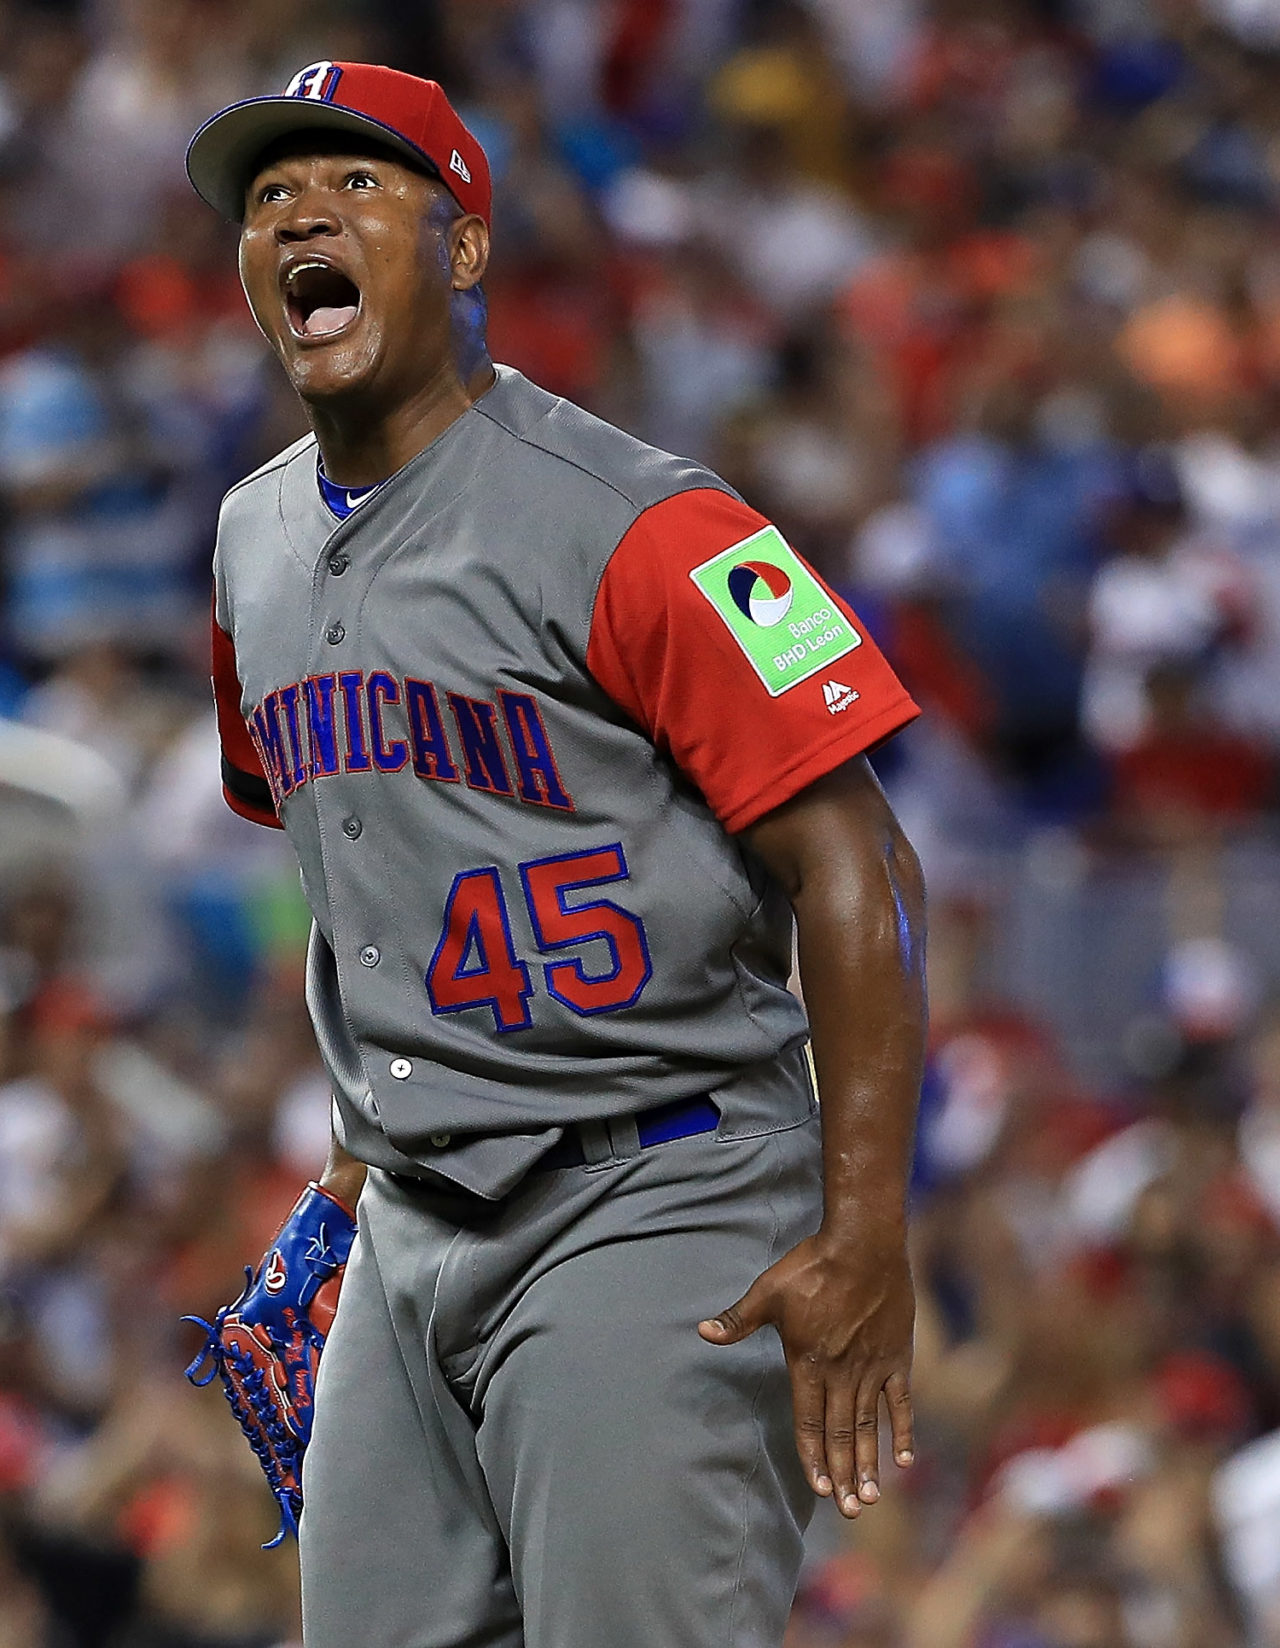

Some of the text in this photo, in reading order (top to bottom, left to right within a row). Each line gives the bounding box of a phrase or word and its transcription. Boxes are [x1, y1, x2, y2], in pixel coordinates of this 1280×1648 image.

[788, 608, 831, 638] Banco
[773, 625, 843, 671] BHD León
[827, 690, 860, 715] Majestic
[248, 669, 576, 814] MINICANA
[425, 841, 653, 1033] 45
